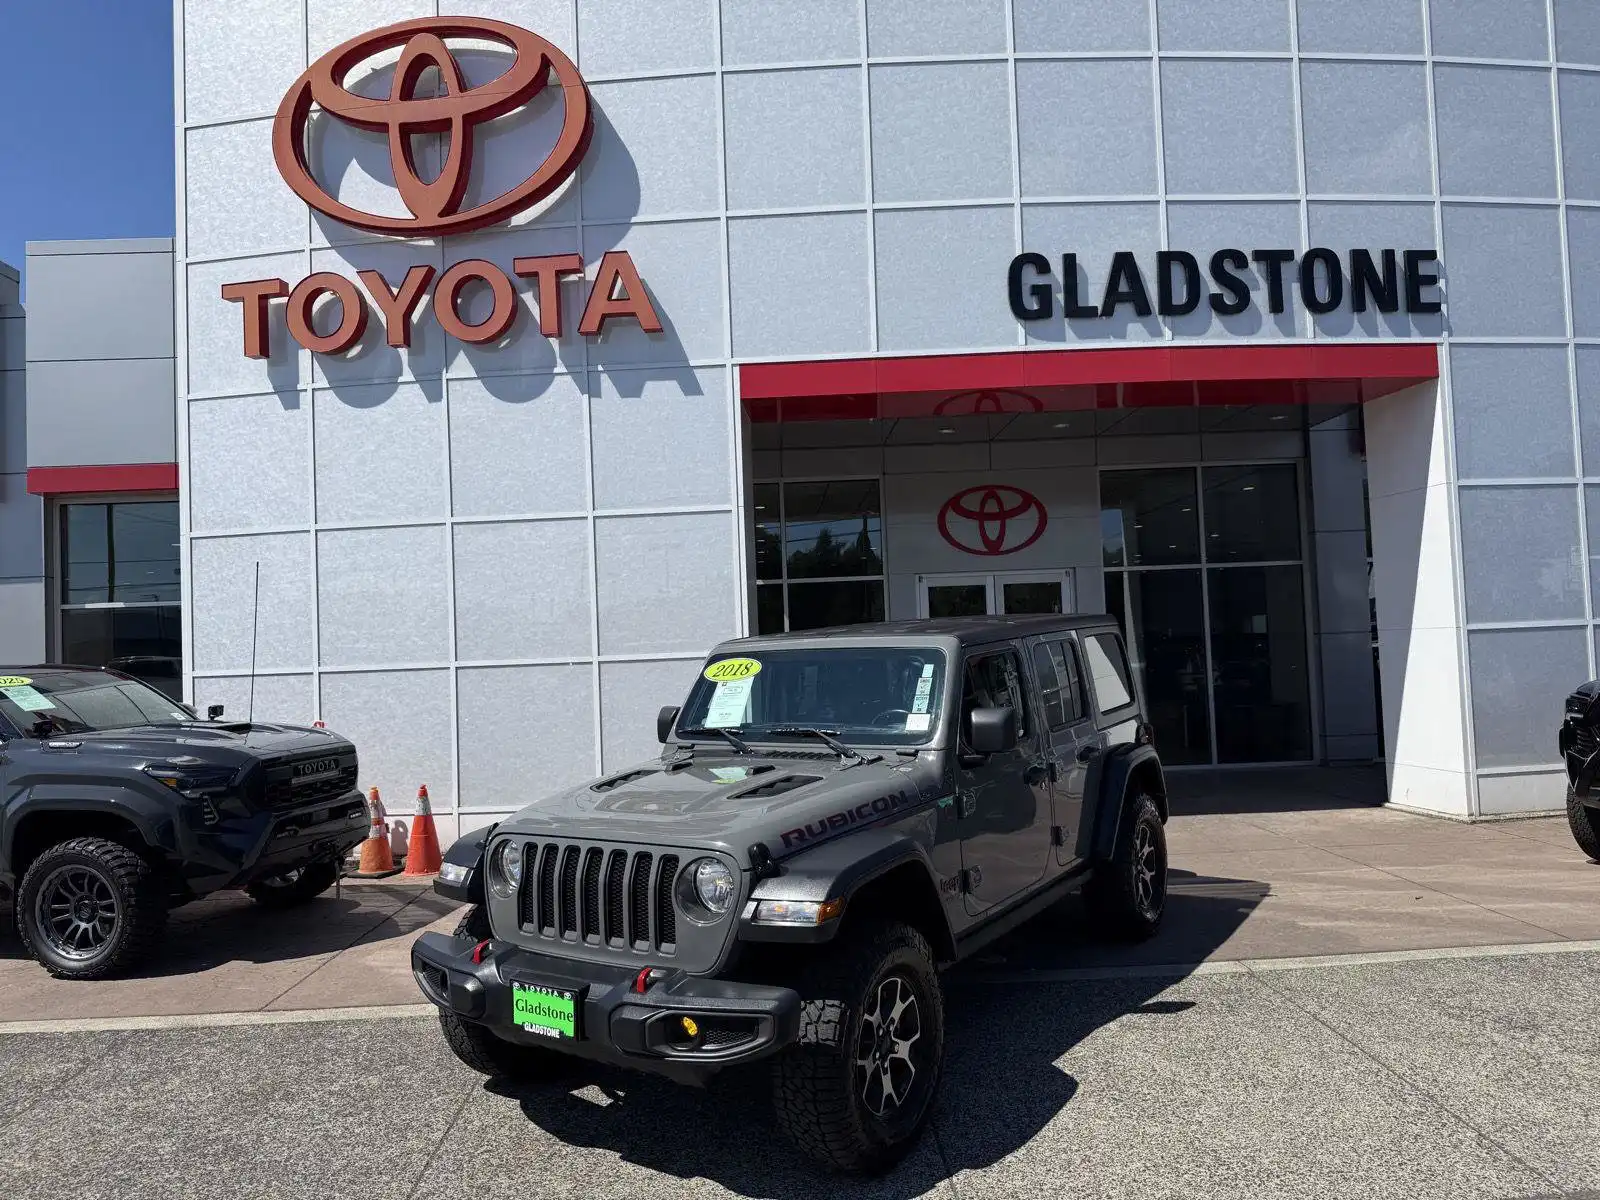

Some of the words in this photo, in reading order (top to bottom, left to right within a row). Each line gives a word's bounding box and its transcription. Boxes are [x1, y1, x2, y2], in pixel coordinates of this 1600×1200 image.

[1007, 247, 1442, 321] GLADSTONE
[221, 250, 664, 360] TOYOTA
[711, 662, 753, 678] 2018
[0, 677, 24, 685] 025
[298, 760, 336, 774] TOYOTA
[780, 790, 909, 849] RUBICON
[524, 984, 559, 997] TOYOTA
[515, 998, 574, 1023] Gladstone
[524, 1022, 560, 1039] GLADSTONE
